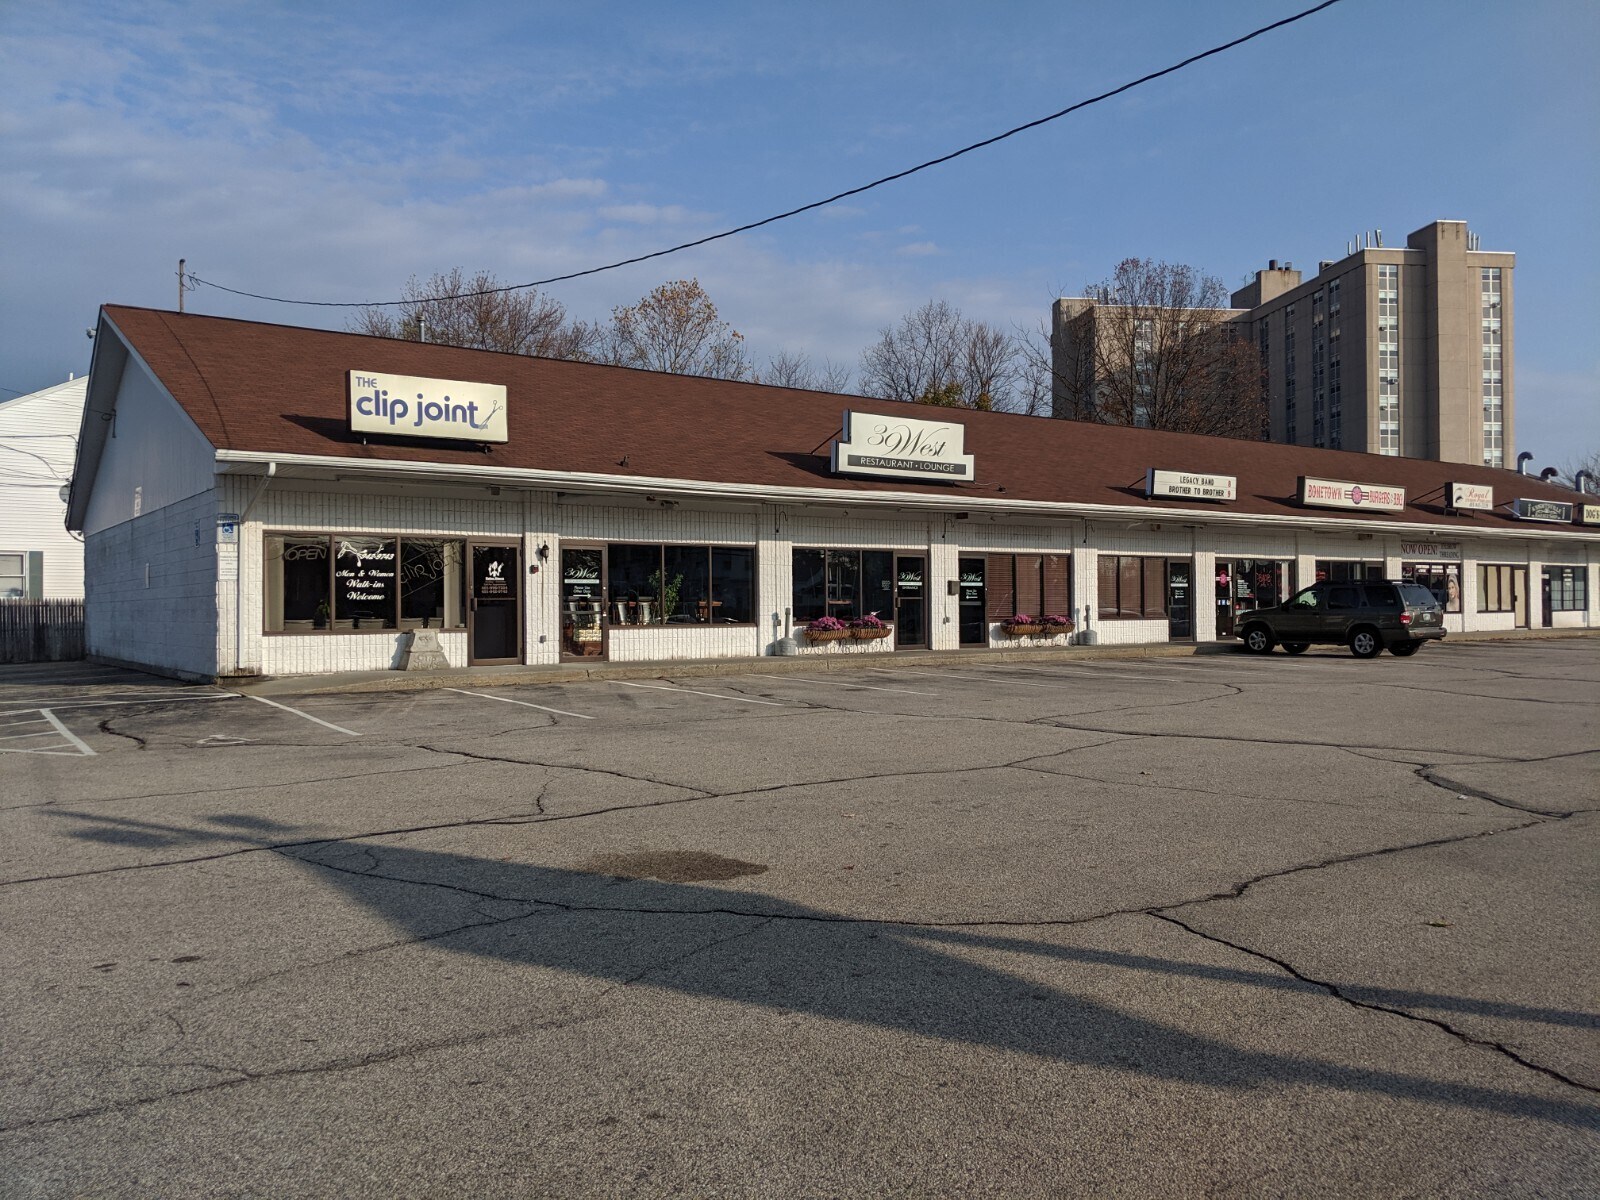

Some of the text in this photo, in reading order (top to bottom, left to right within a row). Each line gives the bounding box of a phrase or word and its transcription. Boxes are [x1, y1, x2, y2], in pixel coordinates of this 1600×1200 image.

[355, 376, 378, 389] THE
[356, 389, 479, 429] clip joint
[860, 456, 955, 473] RESTAURANT LOUNGE
[1180, 475, 1200, 485] LEGACY
[1201, 478, 1214, 486] BAND
[1169, 485, 1191, 495] BROTHER
[1203, 488, 1225, 497] BROTHER
[287, 549, 327, 560] OPEN
[1401, 543, 1417, 554] NOW
[1418, 544, 1438, 555] OPEN!
[336, 569, 355, 577] Men
[368, 569, 395, 577] Women
[346, 579, 385, 588] Walk-ins
[346, 591, 386, 600] Welcome
